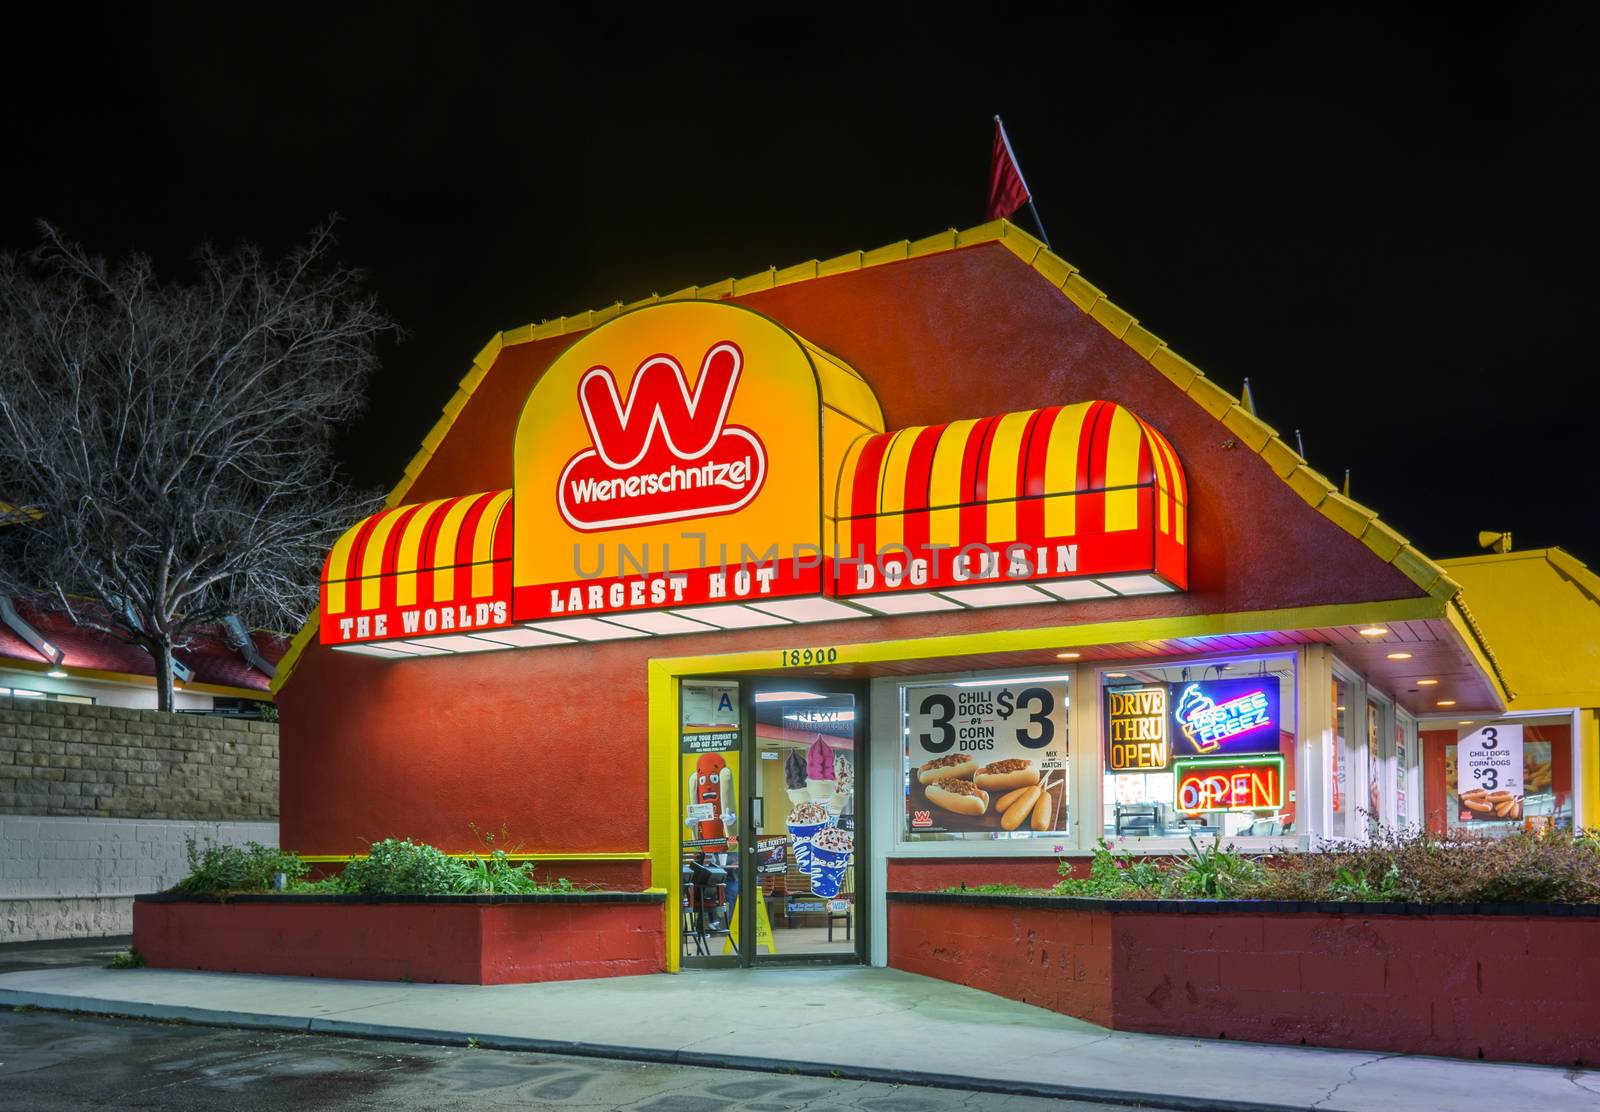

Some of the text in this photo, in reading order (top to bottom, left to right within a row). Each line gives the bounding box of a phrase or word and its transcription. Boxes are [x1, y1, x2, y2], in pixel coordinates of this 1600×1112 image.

[571, 455, 751, 505] Wienerschnitzel
[340, 544, 1078, 640] THE WORLD'S LARGEST HOT DOG CHAIN
[782, 648, 837, 666] 18900
[718, 692, 734, 711] A
[958, 691, 992, 704] CHILI
[1111, 692, 1163, 715] DRIVE
[958, 704, 993, 716] DOGS
[970, 717, 982, 725] or
[996, 687, 1055, 749] $3
[1192, 693, 1269, 728] TASTEE
[919, 694, 956, 753] 3
[959, 727, 994, 739] CORN
[1111, 717, 1162, 740] THRU
[1199, 708, 1269, 743] FREEZ
[959, 739, 994, 751] DOGS
[1481, 727, 1498, 749] 3
[1112, 743, 1163, 768] OPEN
[1473, 768, 1498, 790] $3
[1180, 770, 1273, 814] OPEN
